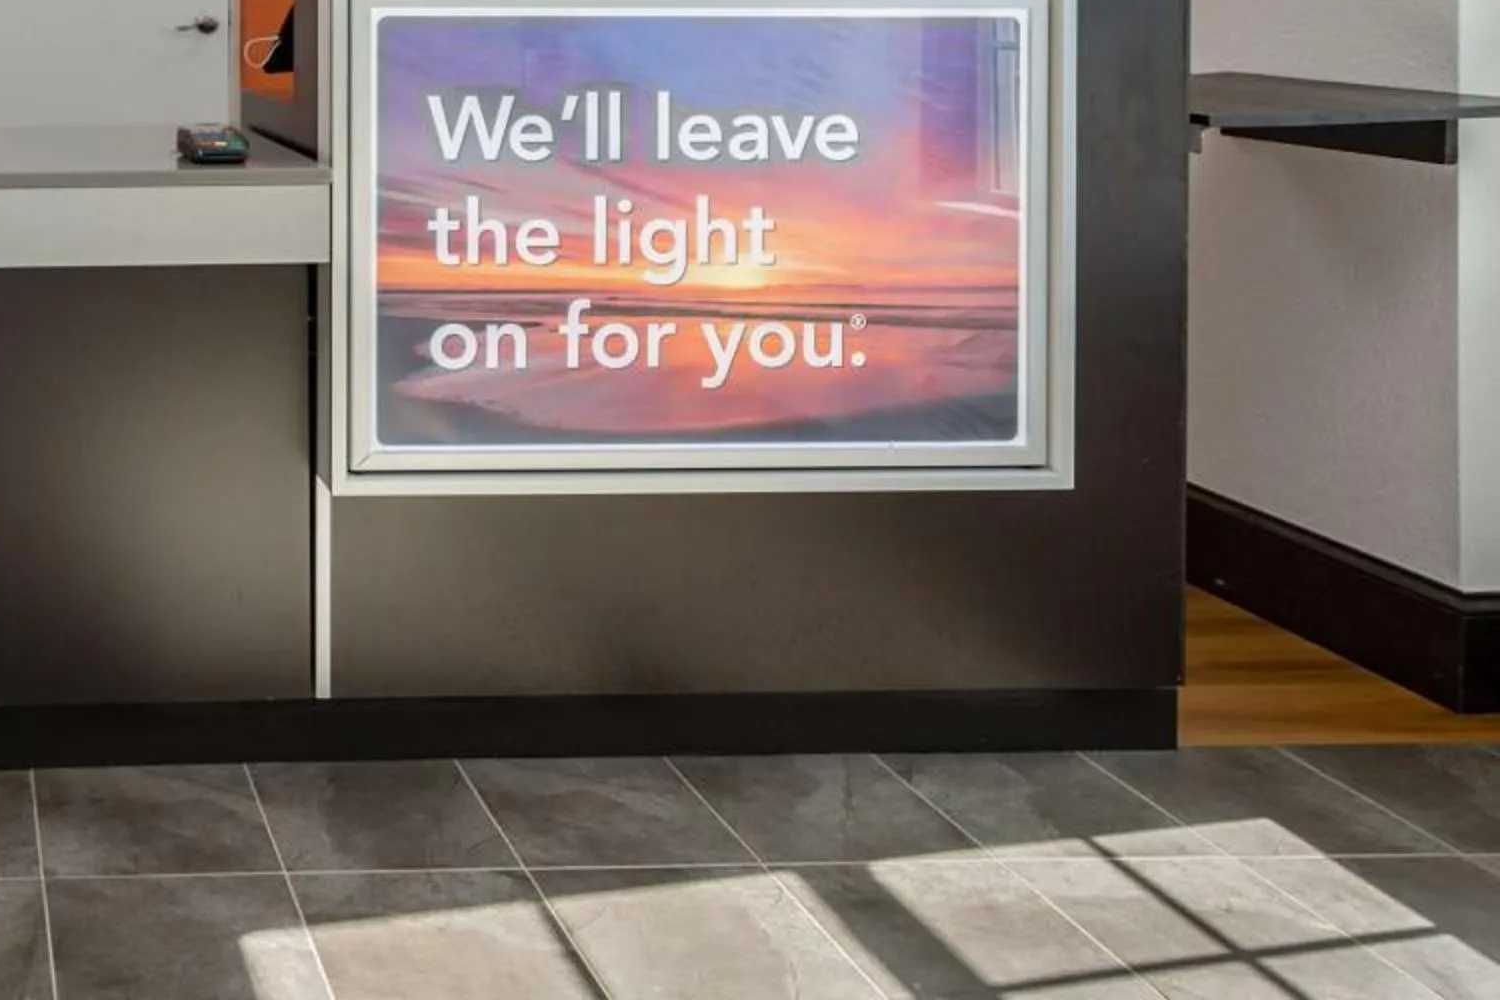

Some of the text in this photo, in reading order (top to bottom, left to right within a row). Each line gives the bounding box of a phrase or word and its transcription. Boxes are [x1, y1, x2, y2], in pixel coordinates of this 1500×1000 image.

[656, 90, 860, 163] leave
[427, 194, 777, 286] the light
[428, 319, 529, 371] on
[558, 298, 677, 370] for
